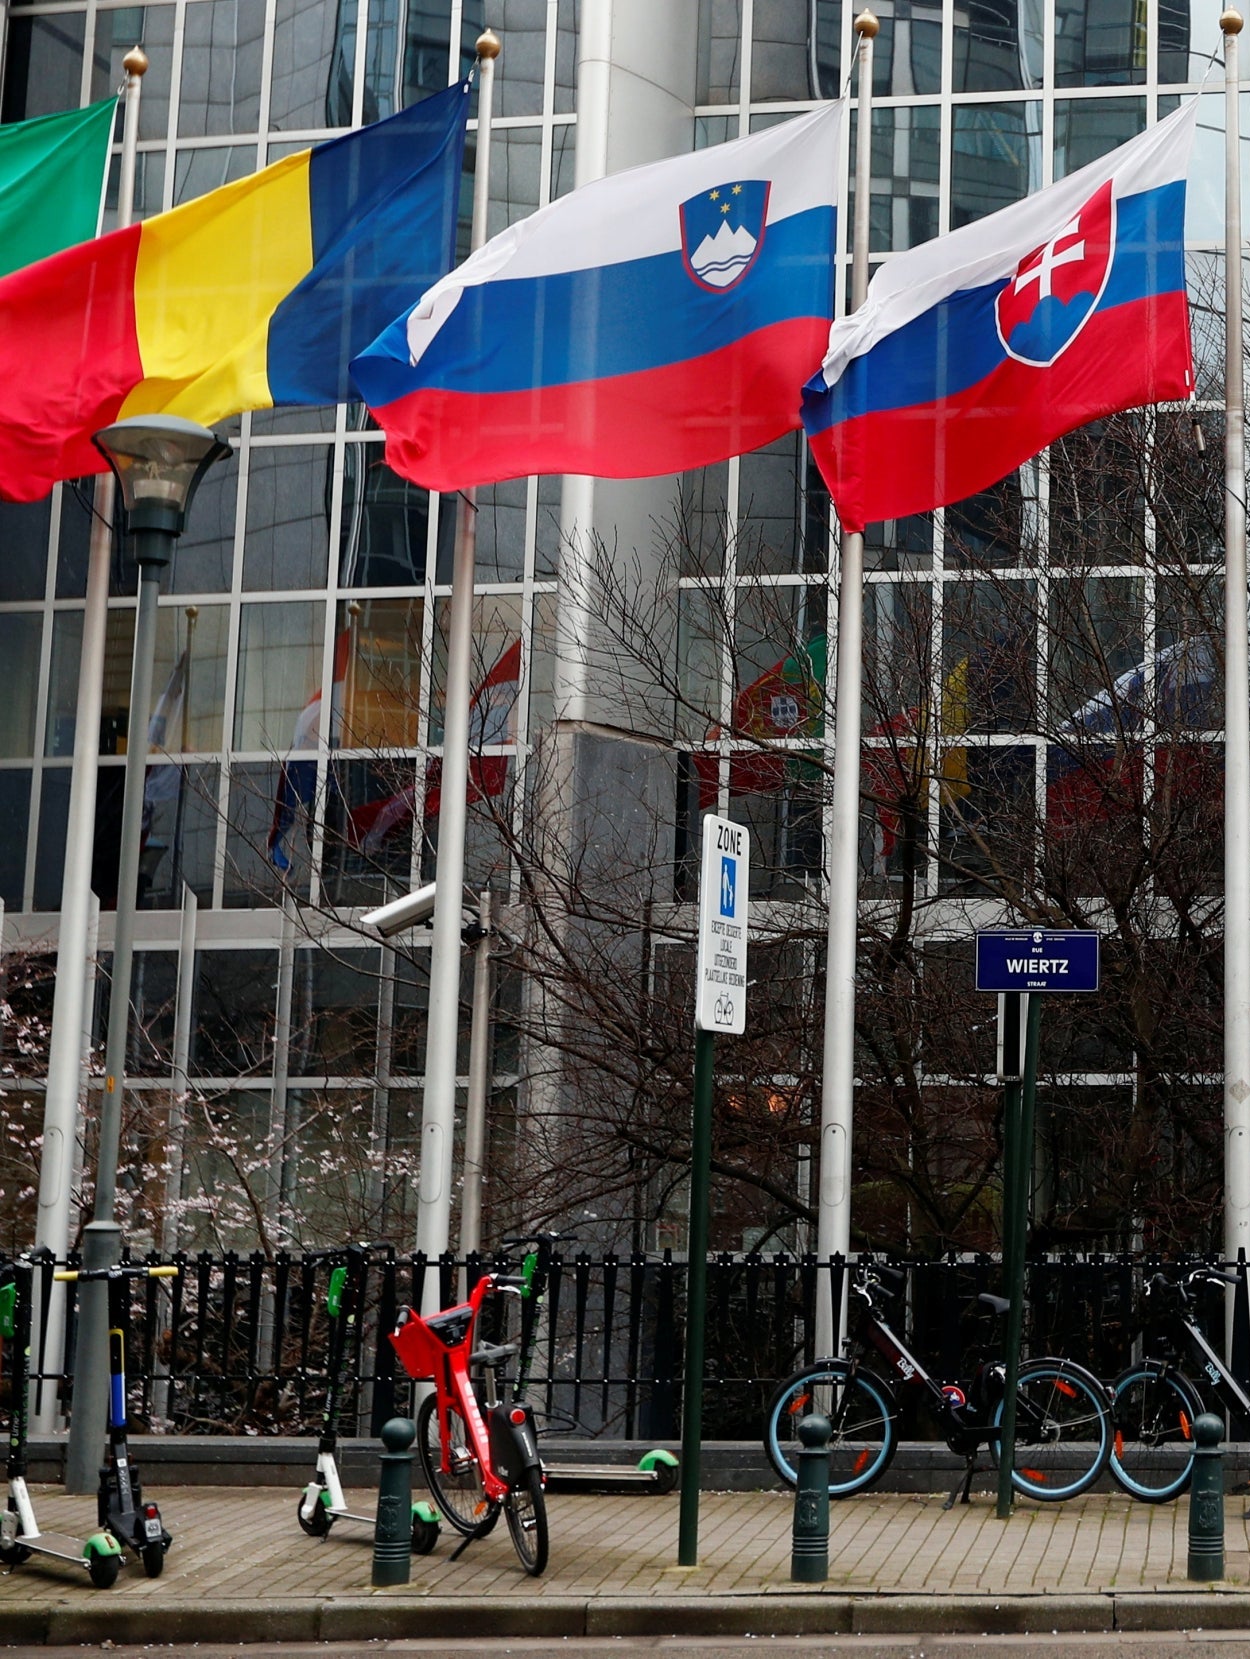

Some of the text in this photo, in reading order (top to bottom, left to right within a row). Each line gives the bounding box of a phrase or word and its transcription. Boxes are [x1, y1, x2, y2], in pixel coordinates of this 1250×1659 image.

[717, 824, 742, 857] ZONE
[1006, 958, 1069, 974] WIERTZ
[896, 1356, 915, 1381] Billy
